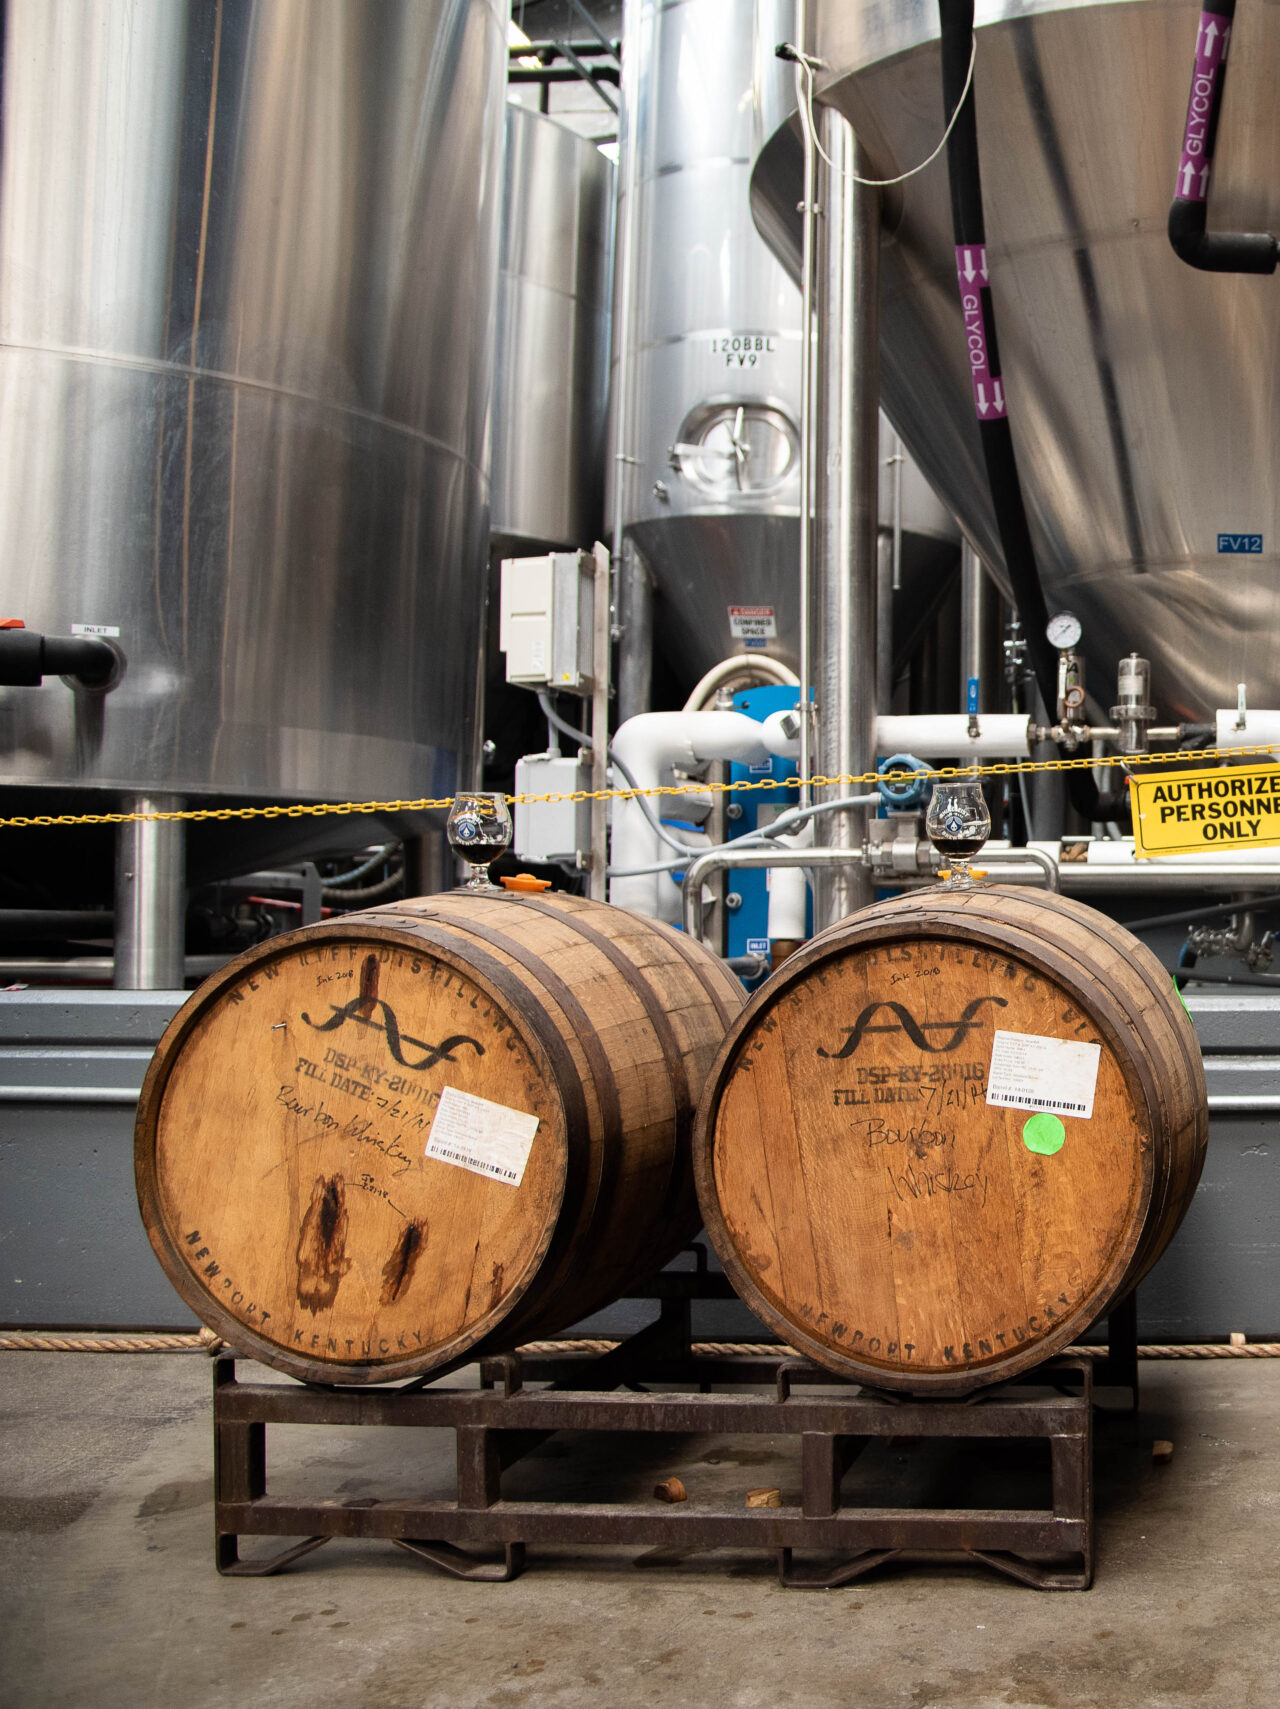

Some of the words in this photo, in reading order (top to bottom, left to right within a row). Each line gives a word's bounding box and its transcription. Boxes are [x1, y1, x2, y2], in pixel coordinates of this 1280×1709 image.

[1186, 68, 1214, 156] GLYCOL
[712, 337, 775, 352] 120BBL
[963, 295, 985, 376] GLYCOL
[726, 354, 757, 367] FV9
[1219, 537, 1261, 551] FV12
[1202, 819, 1261, 840] ONLY
[294, 1057, 327, 1083] FILL
[833, 1088, 870, 1106] FILL
[851, 1118, 956, 1149] Bourbon
[944, 1292, 1071, 1363] KENTUCKY
